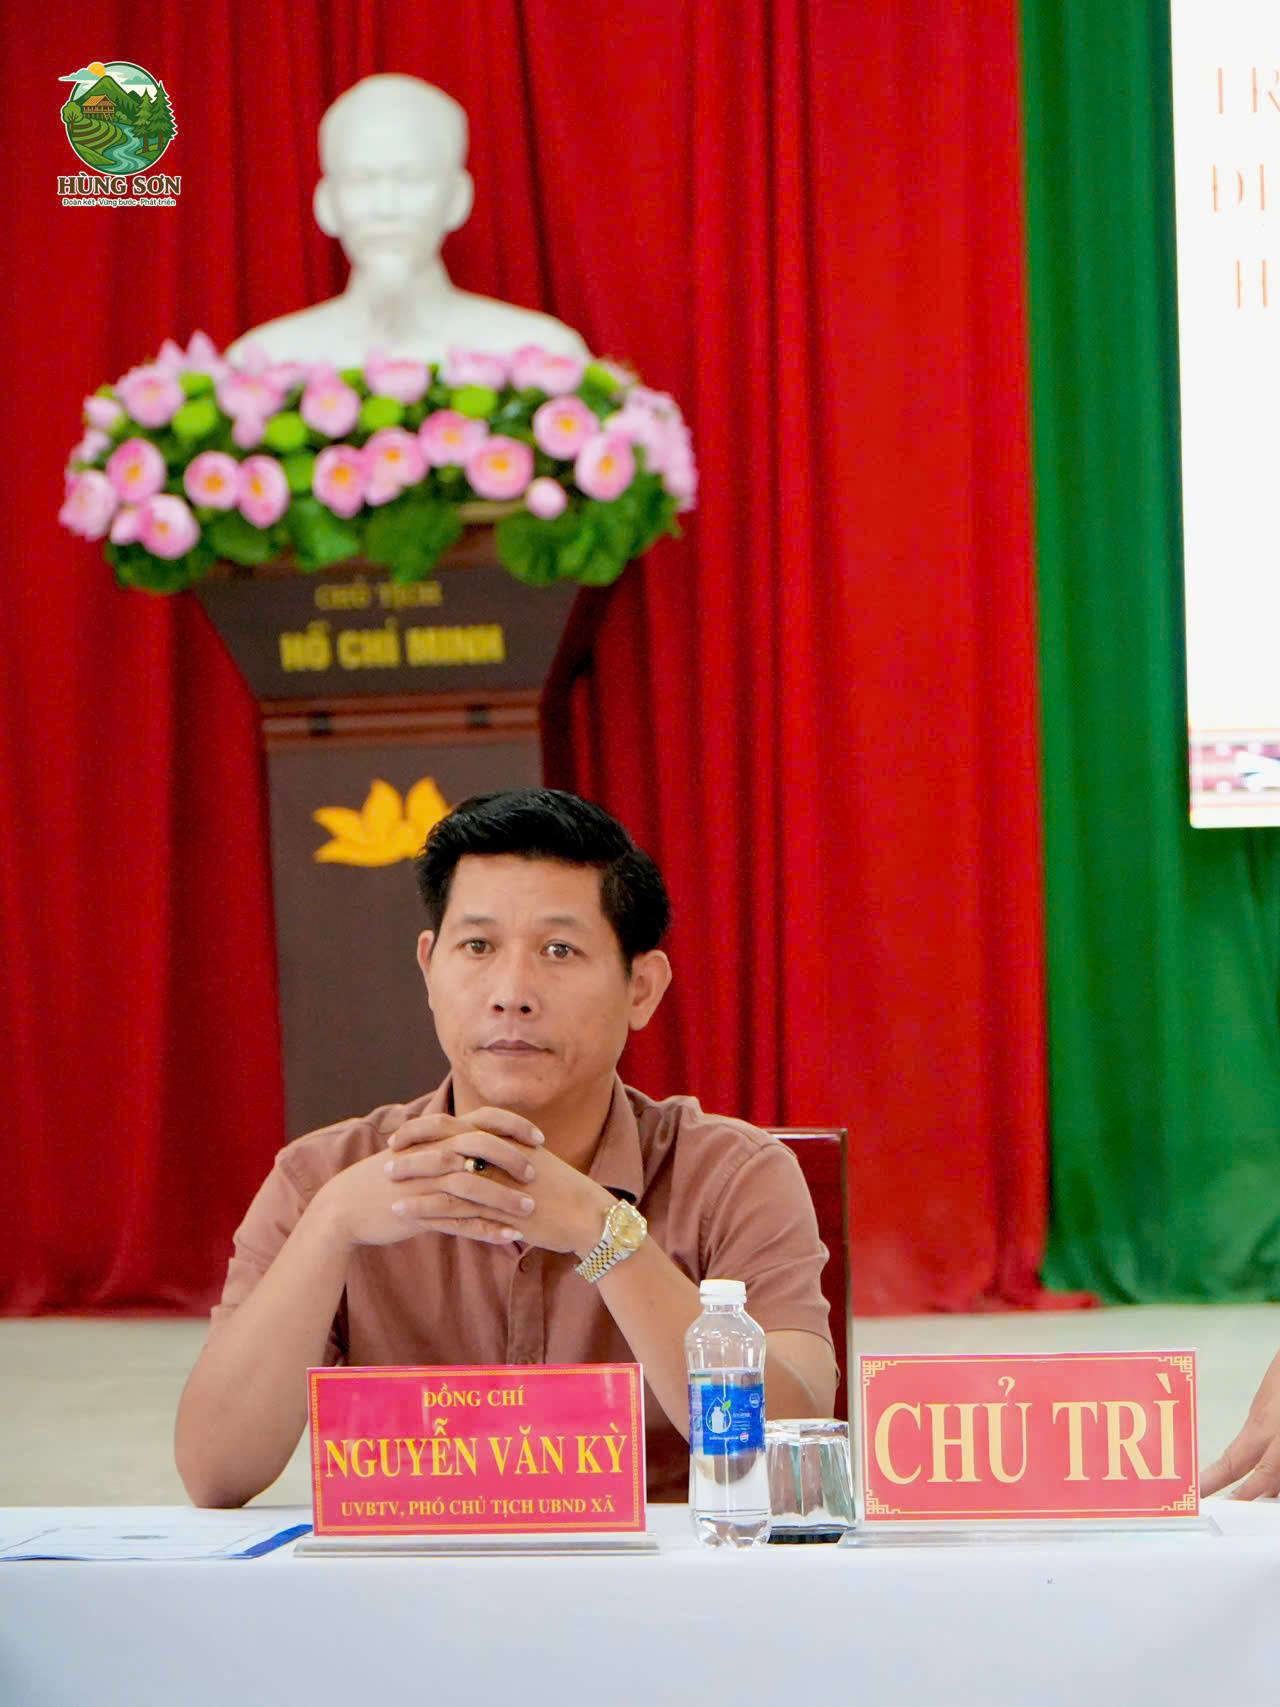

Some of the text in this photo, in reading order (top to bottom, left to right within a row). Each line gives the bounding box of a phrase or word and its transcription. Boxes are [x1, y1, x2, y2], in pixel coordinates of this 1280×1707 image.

[423, 1383, 524, 1408] ĐỒNG CHÍ
[324, 1417, 628, 1477] NGUYỄN VĂN KỲ
[874, 1372, 1182, 1485] CHỦ TRÌ
[341, 1494, 615, 1518] UVBTV, PHÓ CHỦ TỊCH UBND XÃ
